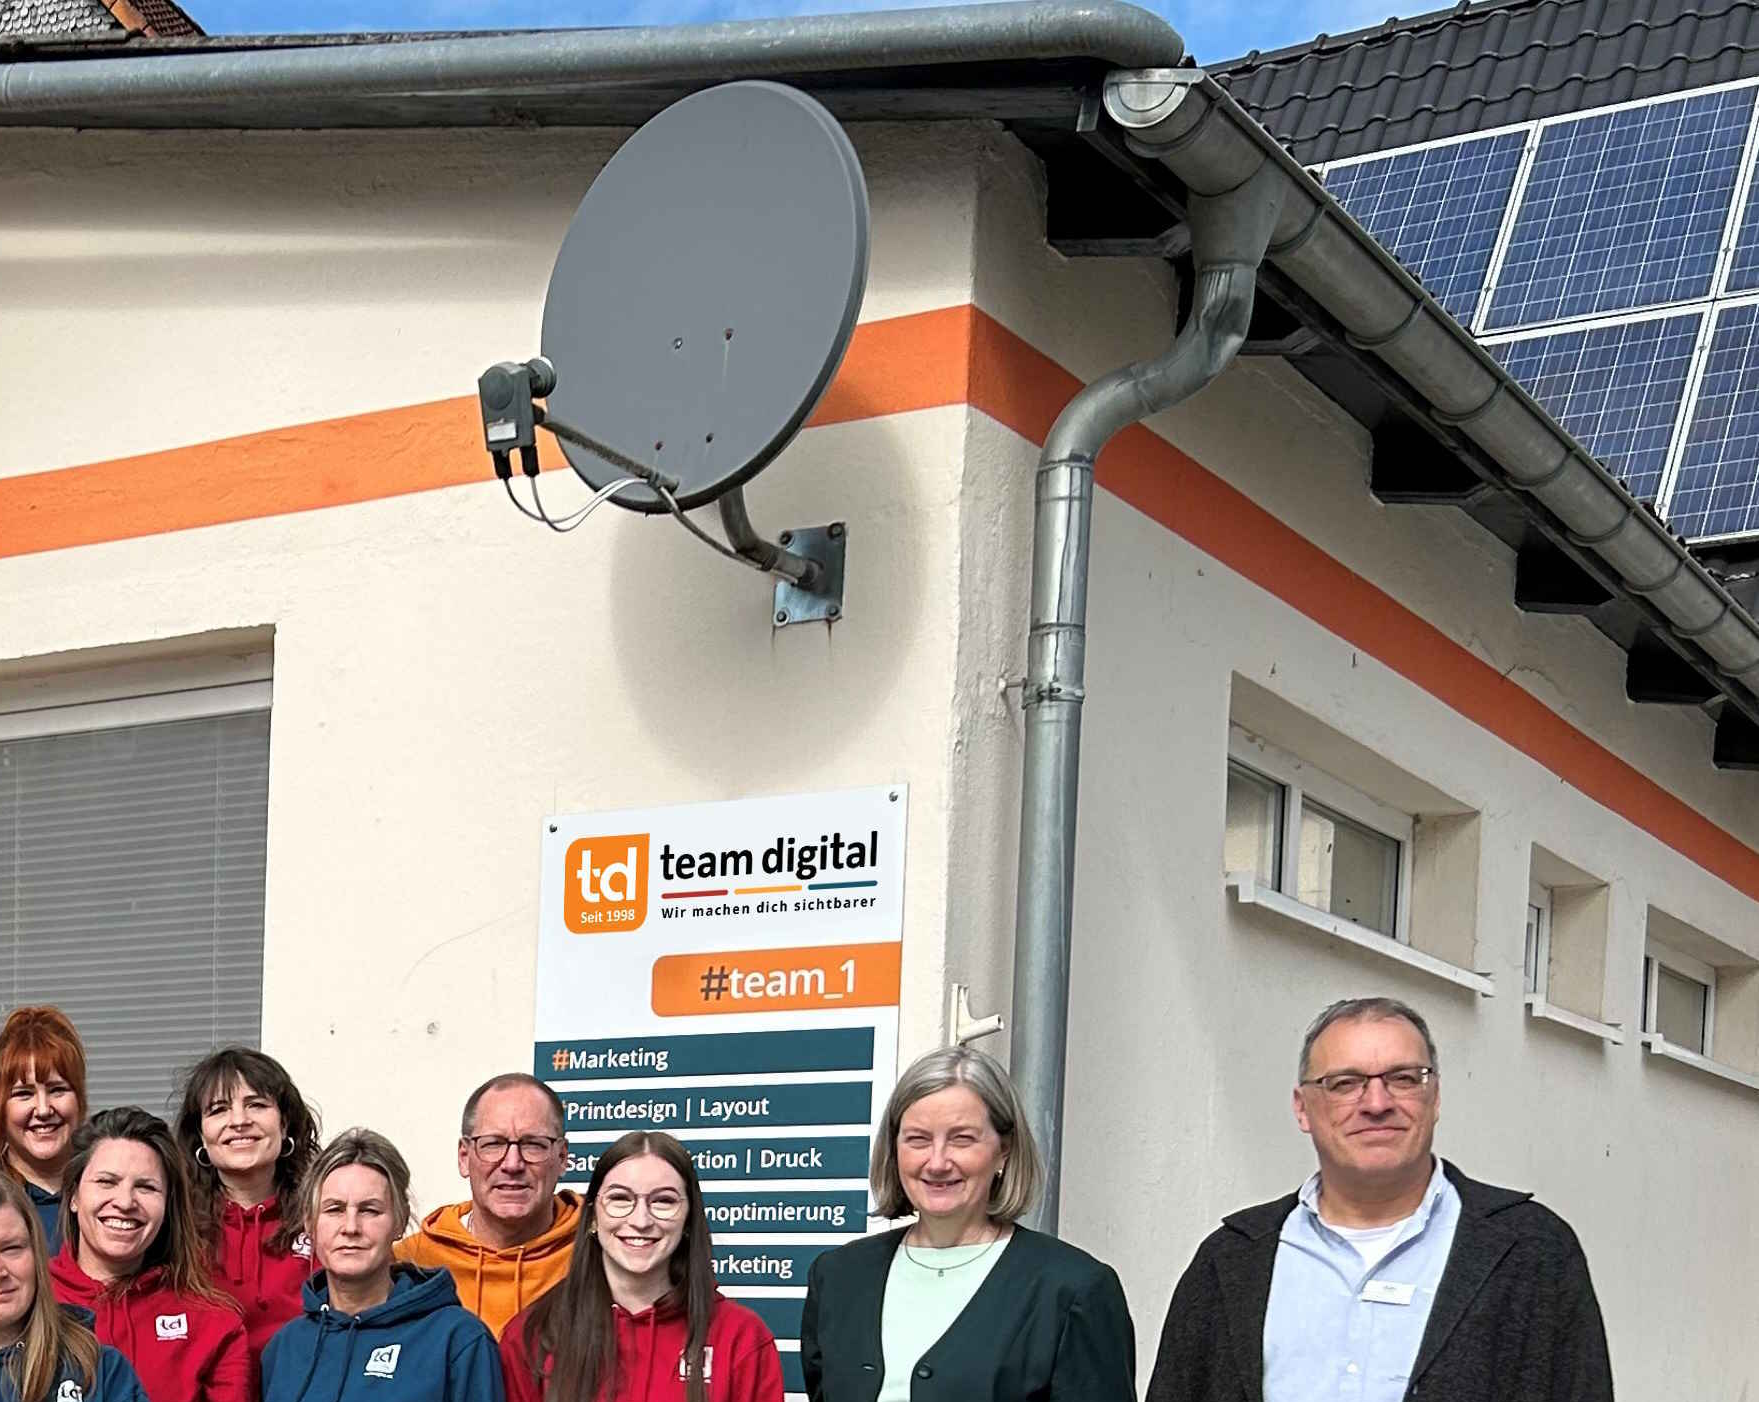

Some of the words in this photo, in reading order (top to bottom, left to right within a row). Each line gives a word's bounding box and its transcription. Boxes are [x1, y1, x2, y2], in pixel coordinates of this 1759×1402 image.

[660, 844, 753, 880] team
[762, 830, 878, 880] digital
[576, 847, 638, 903] td
[580, 911, 603, 924] Seit
[606, 909, 635, 922] 1998
[661, 905, 687, 919] Wir
[692, 903, 750, 917] machen
[756, 900, 788, 914] dich
[794, 896, 876, 912] sichtbarer
[700, 959, 855, 1000] #team_1
[552, 1048, 669, 1071] #Marketing
[700, 1097, 770, 1121] Layout
[565, 1153, 600, 1172] Sat
[760, 1148, 823, 1169] Druck
[704, 1202, 846, 1226] noptimierung
[710, 1254, 793, 1279] arketing
